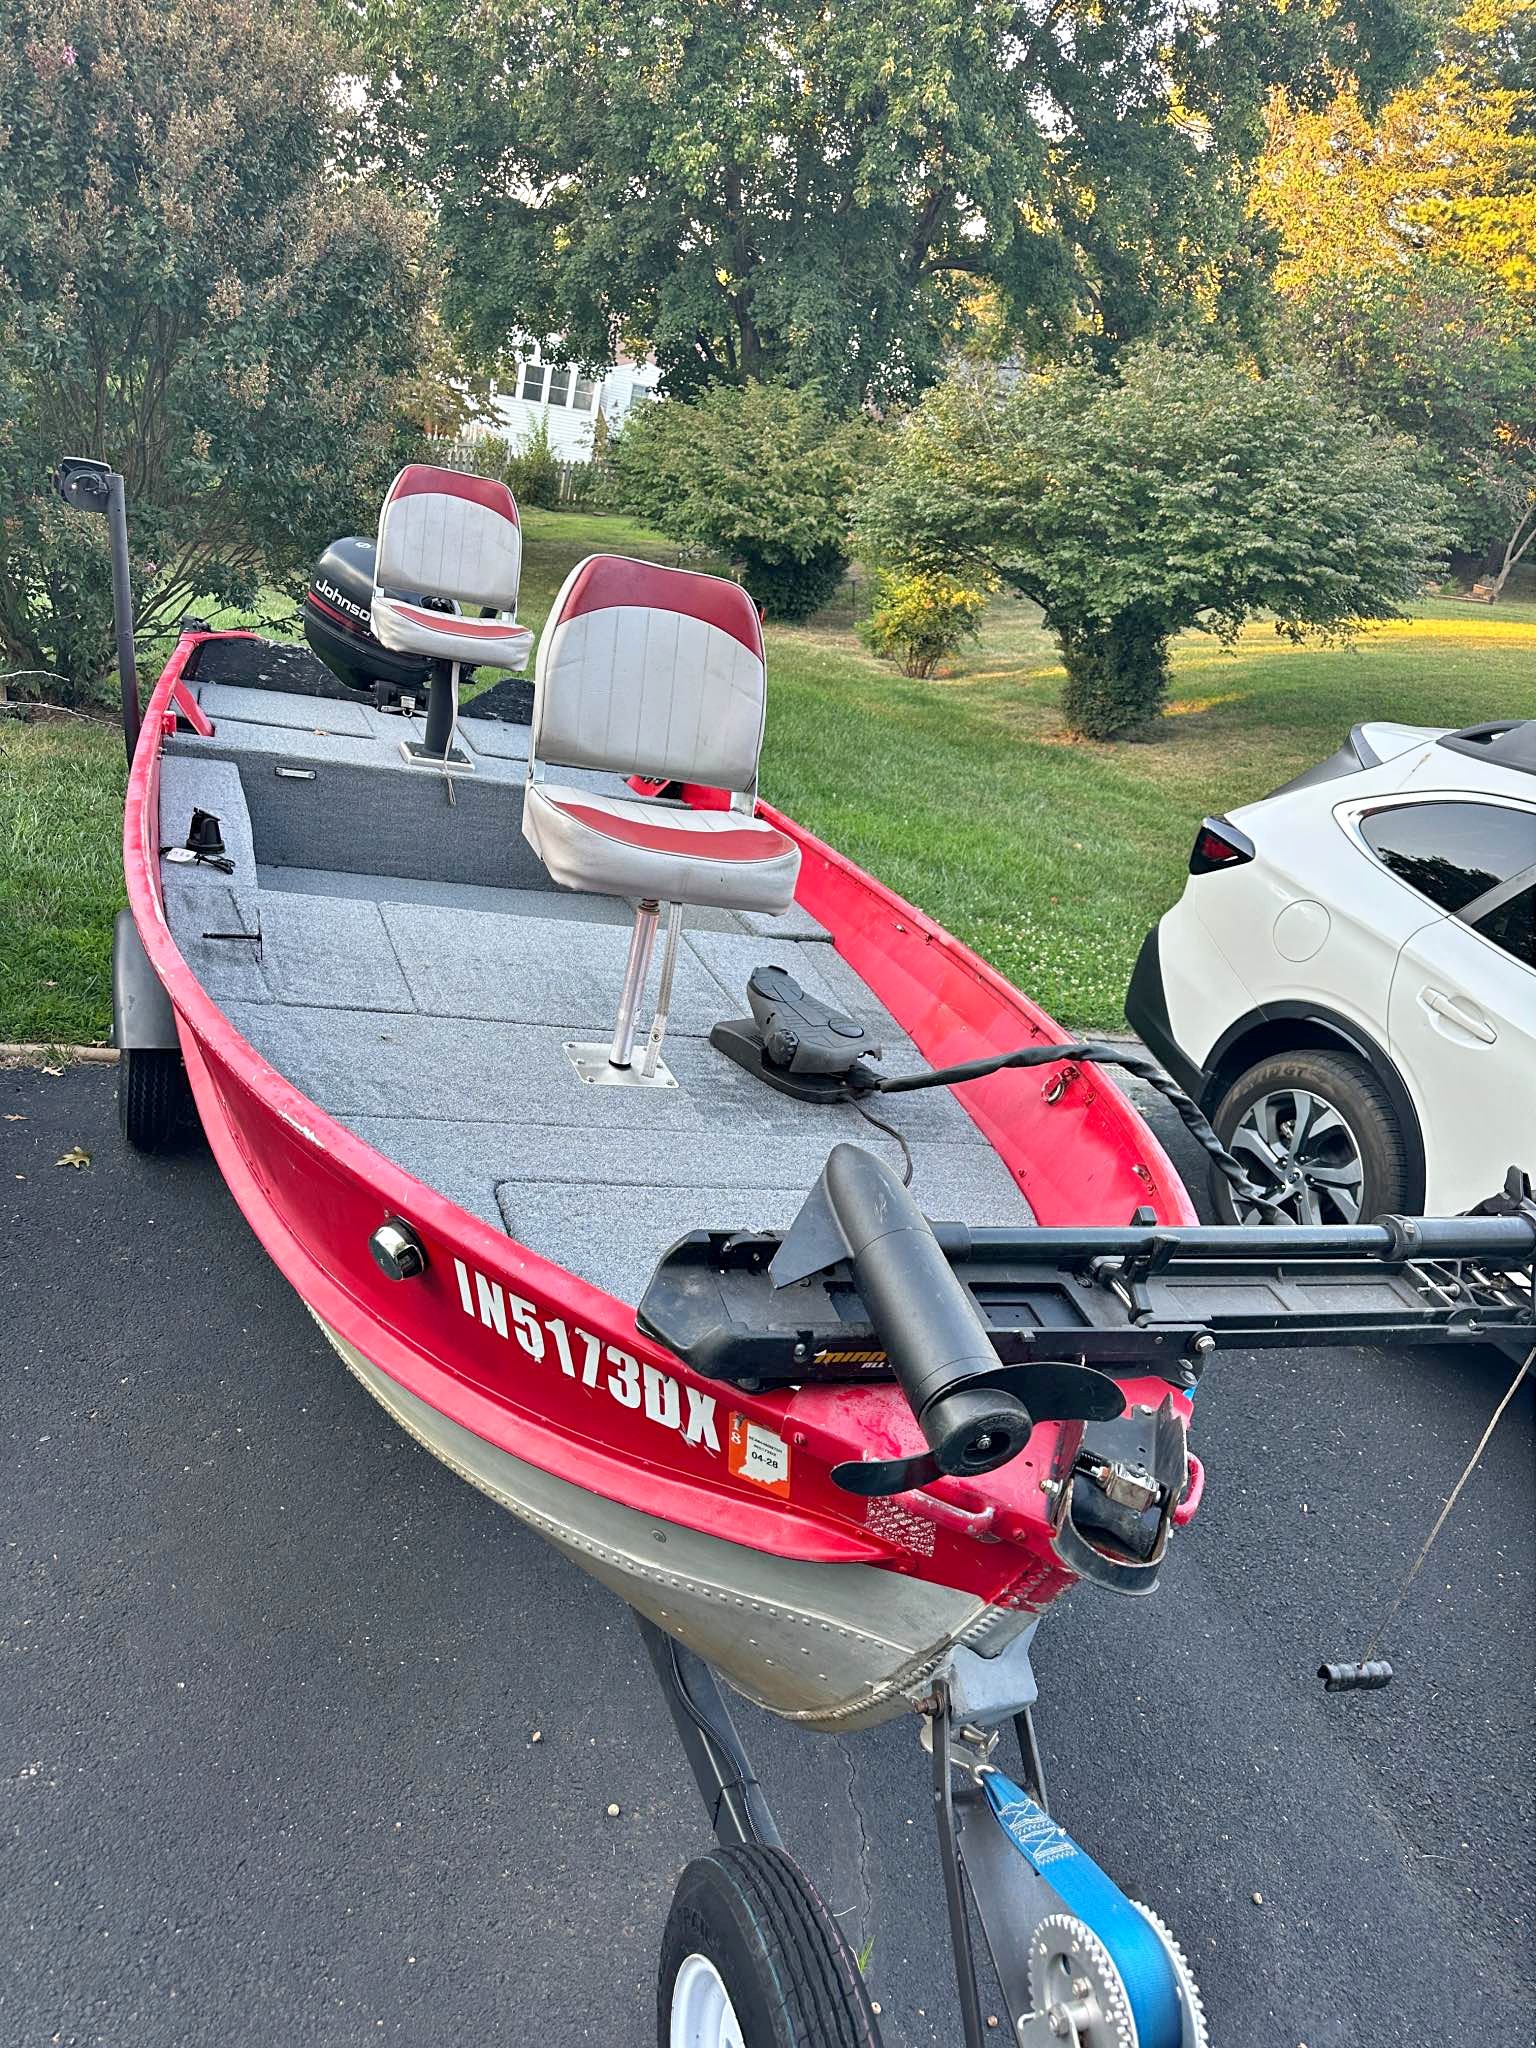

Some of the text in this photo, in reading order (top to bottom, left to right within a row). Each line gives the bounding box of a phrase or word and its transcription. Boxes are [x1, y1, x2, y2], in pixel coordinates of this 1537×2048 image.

[315, 579, 371, 622] Johnso
[453, 1256, 721, 1453] IN5173DX
[751, 1451, 779, 1469] 04-28
